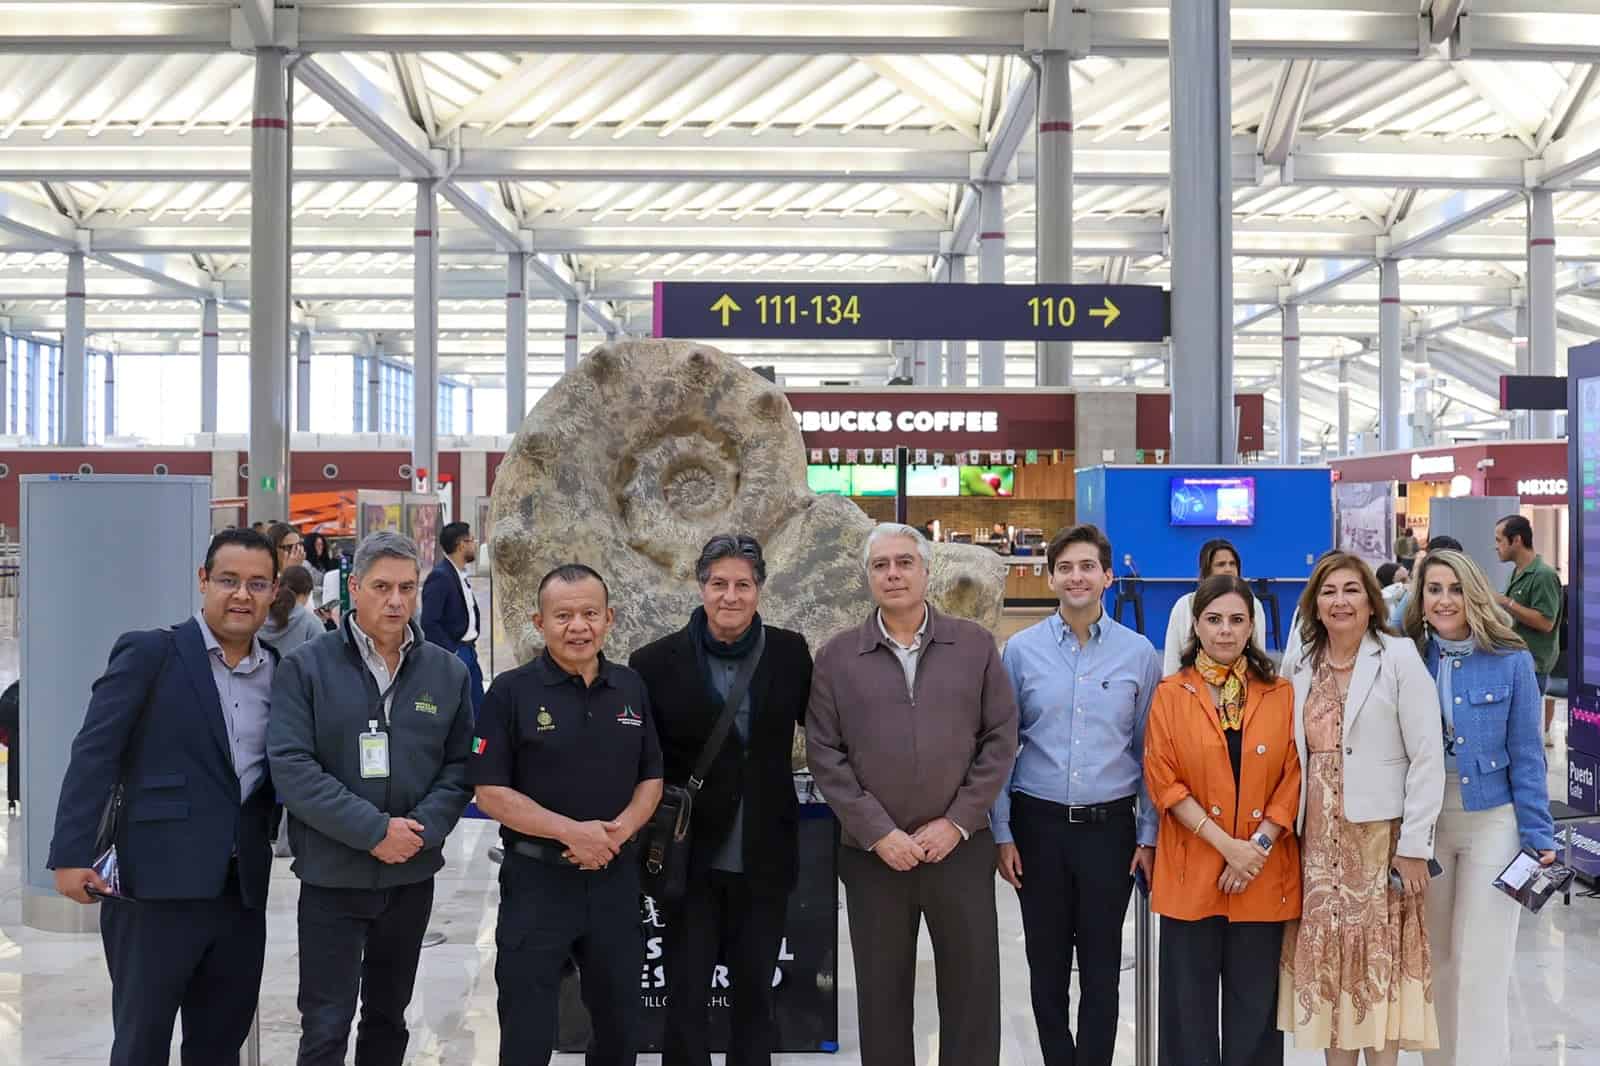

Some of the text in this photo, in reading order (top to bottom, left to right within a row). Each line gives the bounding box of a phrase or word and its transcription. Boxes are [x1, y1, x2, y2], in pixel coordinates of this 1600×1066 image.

[755, 295, 861, 325] 111-134
[1027, 297, 1076, 327] 110
[896, 411, 999, 432] COFFEE
[1570, 761, 1593, 786] Puerta
